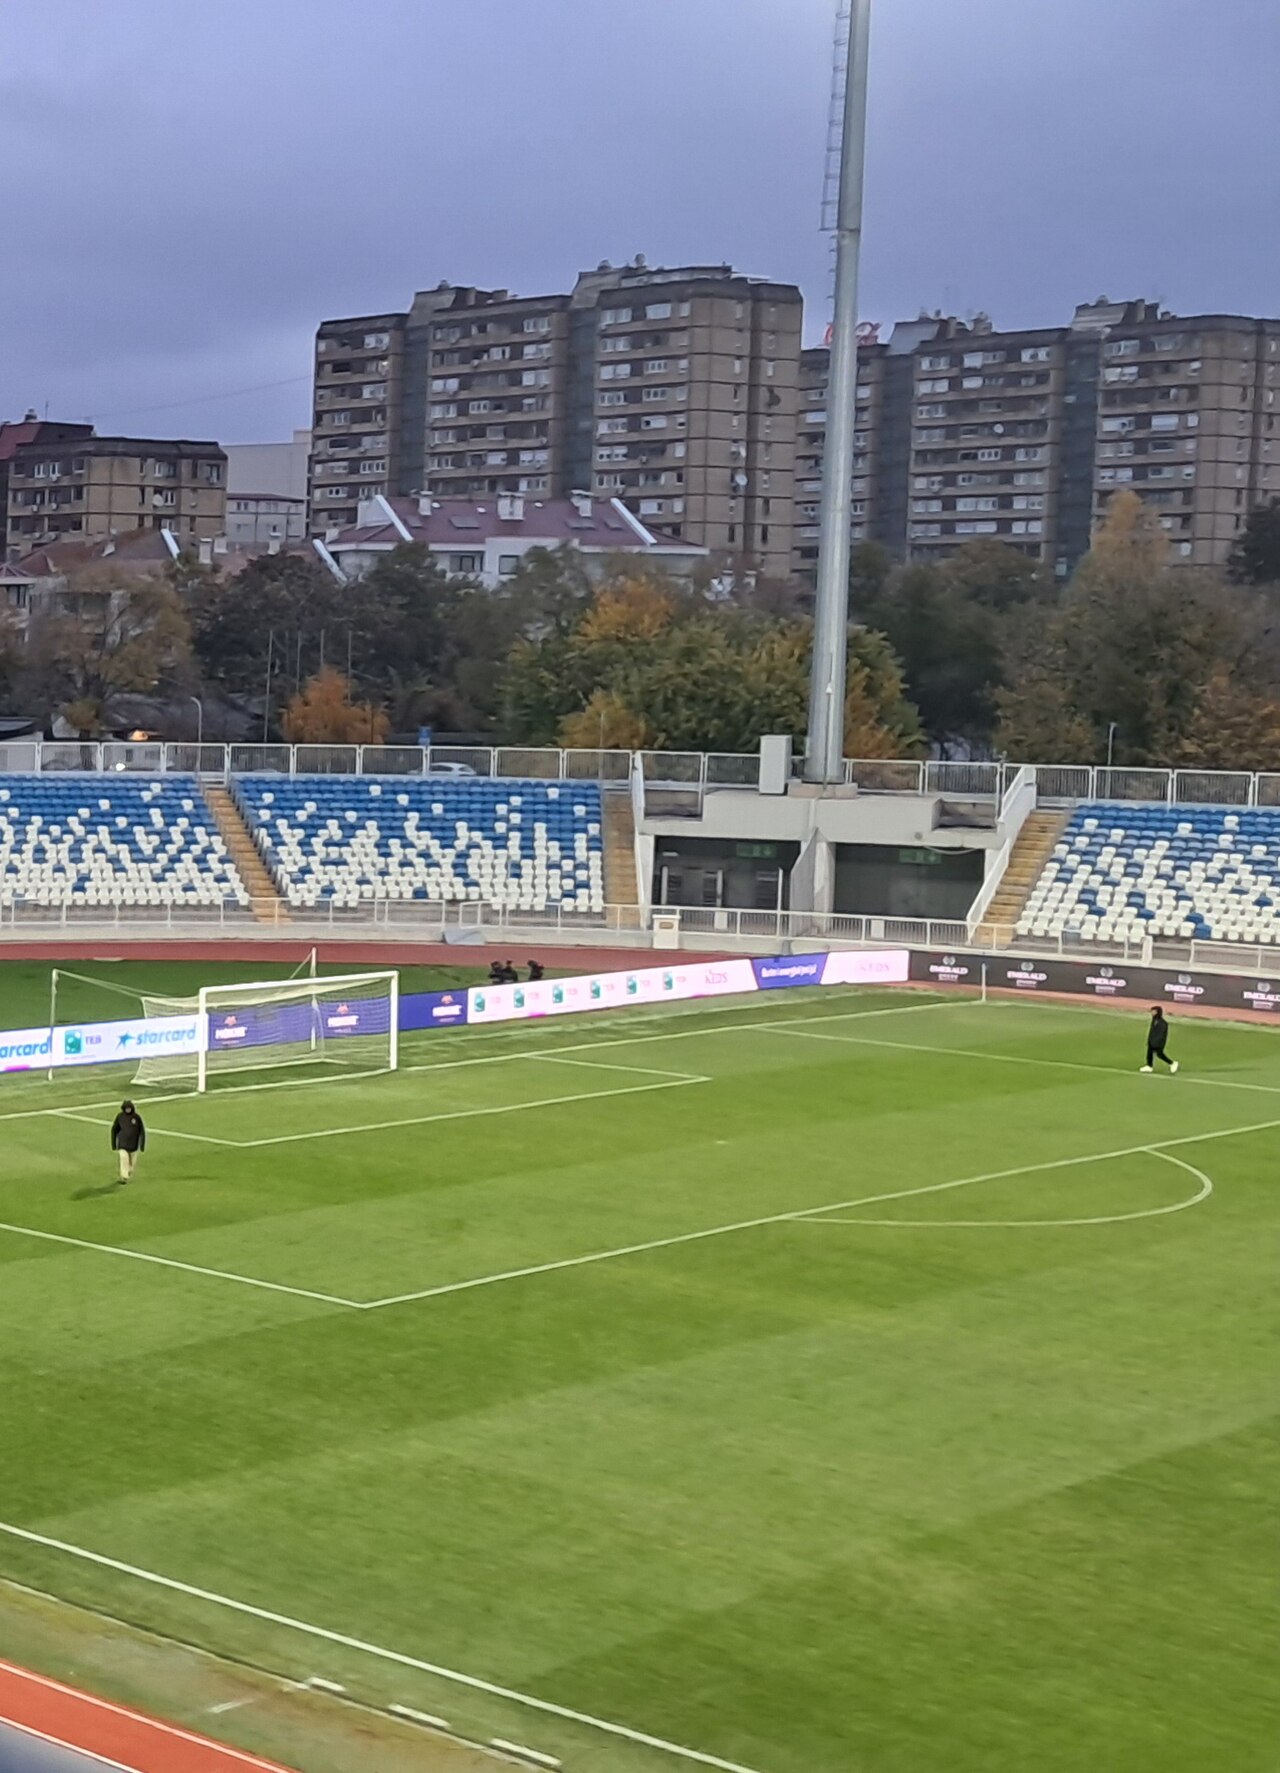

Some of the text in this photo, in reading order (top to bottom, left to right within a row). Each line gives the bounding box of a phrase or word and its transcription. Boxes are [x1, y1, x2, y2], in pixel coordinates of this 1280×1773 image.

[929, 964, 969, 975] EMERALD
[1006, 970, 1047, 981] EMERALD
[1085, 976, 1127, 987] EMERALD
[1164, 983, 1205, 995] EMERALD
[135, 1021, 197, 1046] starcard
